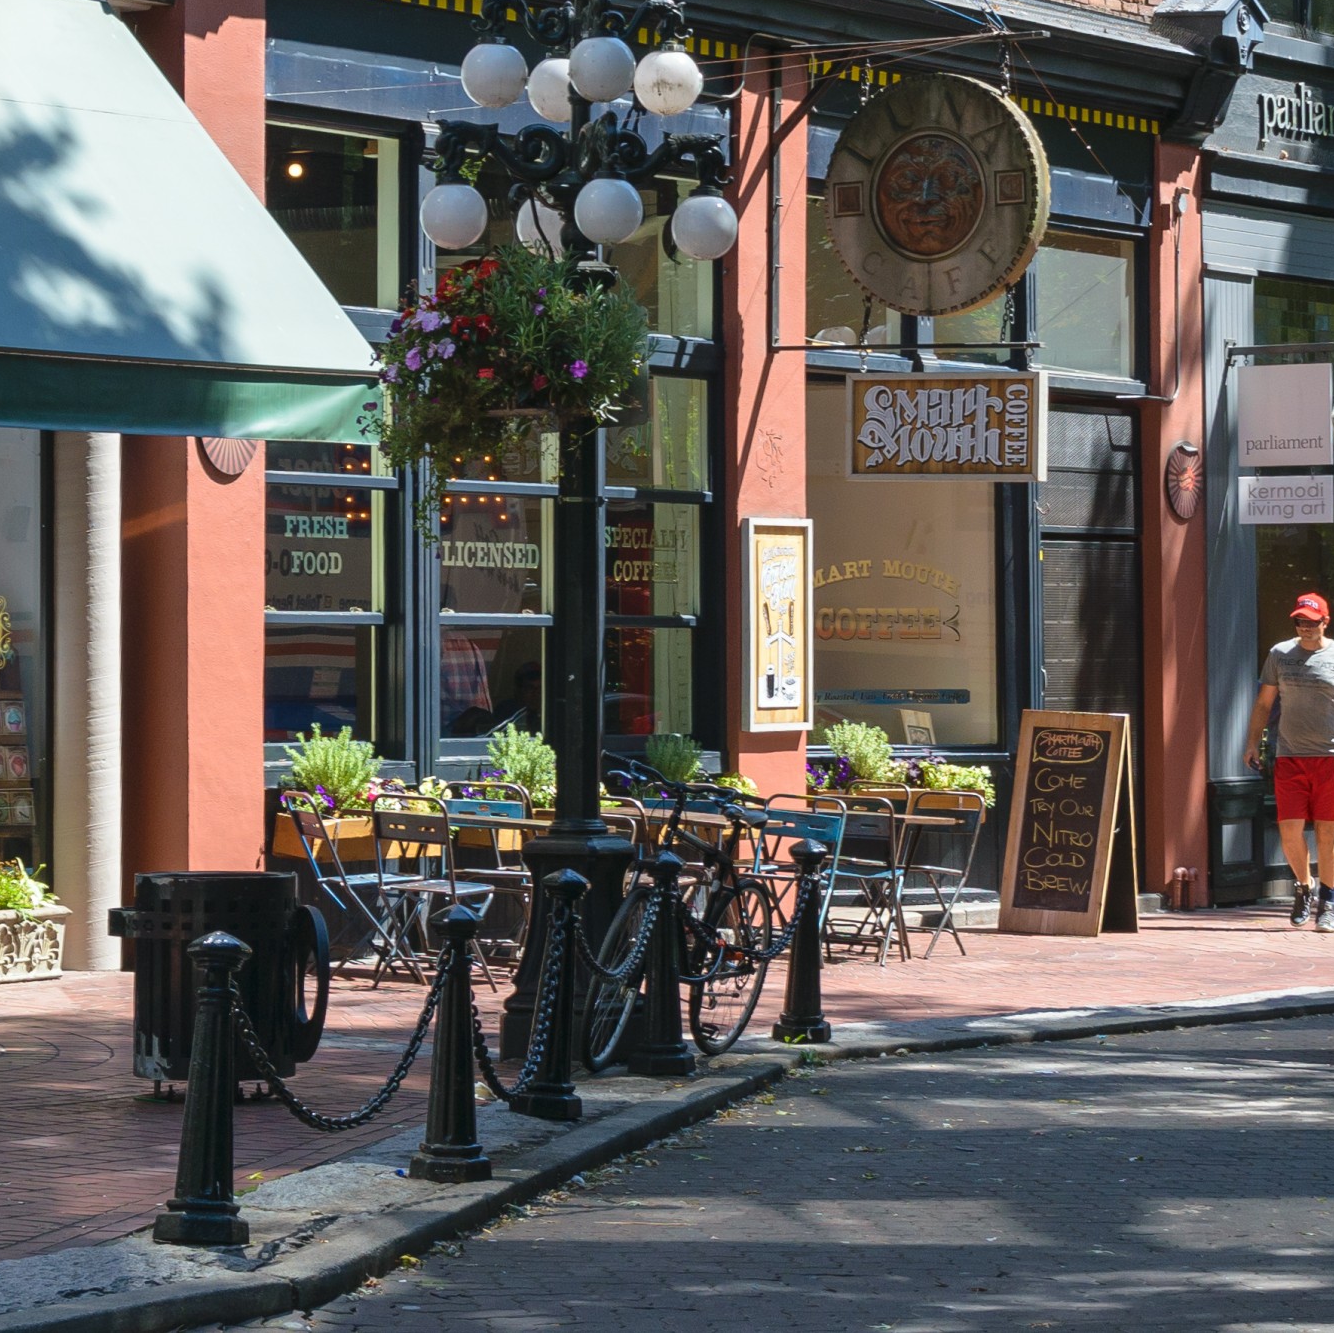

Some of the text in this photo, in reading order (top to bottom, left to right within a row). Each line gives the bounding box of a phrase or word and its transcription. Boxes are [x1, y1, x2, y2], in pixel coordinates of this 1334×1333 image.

[1005, 383, 1029, 467] COFFEE
[1245, 434, 1324, 456] parliament
[1248, 482, 1324, 499] kermodi
[1248, 501, 1326, 519] living art
[284, 515, 349, 539] FRESH
[291, 551, 343, 575] FOOD
[441, 540, 540, 569] LICENSED
[813, 560, 871, 589] MART
[883, 560, 962, 599] MOUTH
[817, 606, 942, 640] COFFEE
[1032, 820, 1094, 849] NITRO
[1023, 846, 1086, 869] COLD
[1020, 868, 1089, 896] BREW
